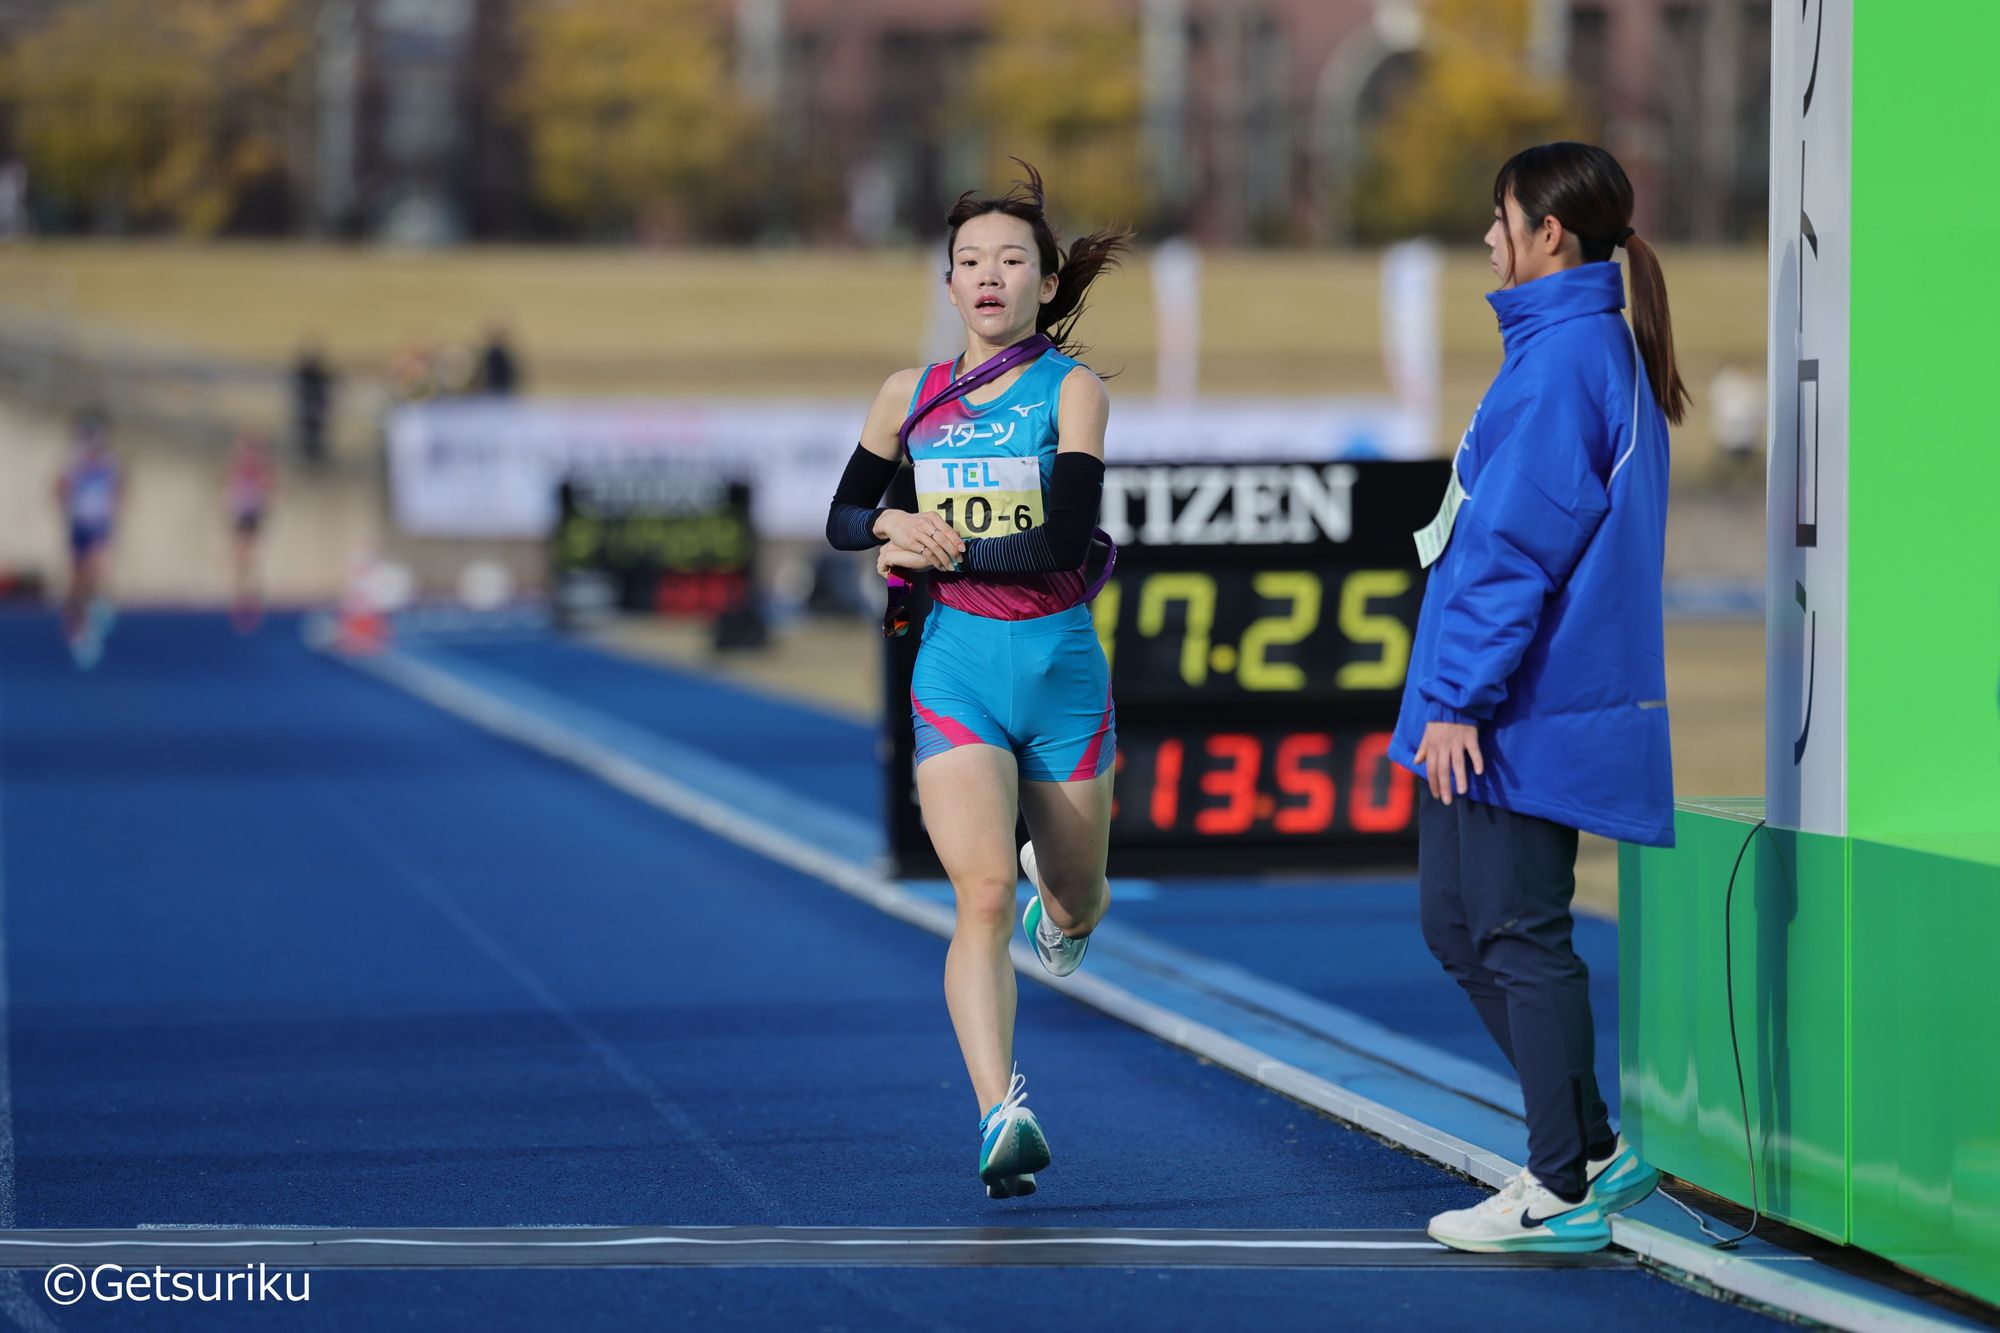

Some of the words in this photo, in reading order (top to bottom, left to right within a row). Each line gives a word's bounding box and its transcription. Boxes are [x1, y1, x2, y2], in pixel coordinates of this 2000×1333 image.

[932, 421, 1016, 448] スターツ
[942, 461, 1000, 489] TEL
[936, 496, 1033, 534] 10-6
[1098, 463, 1354, 546] TIZEN
